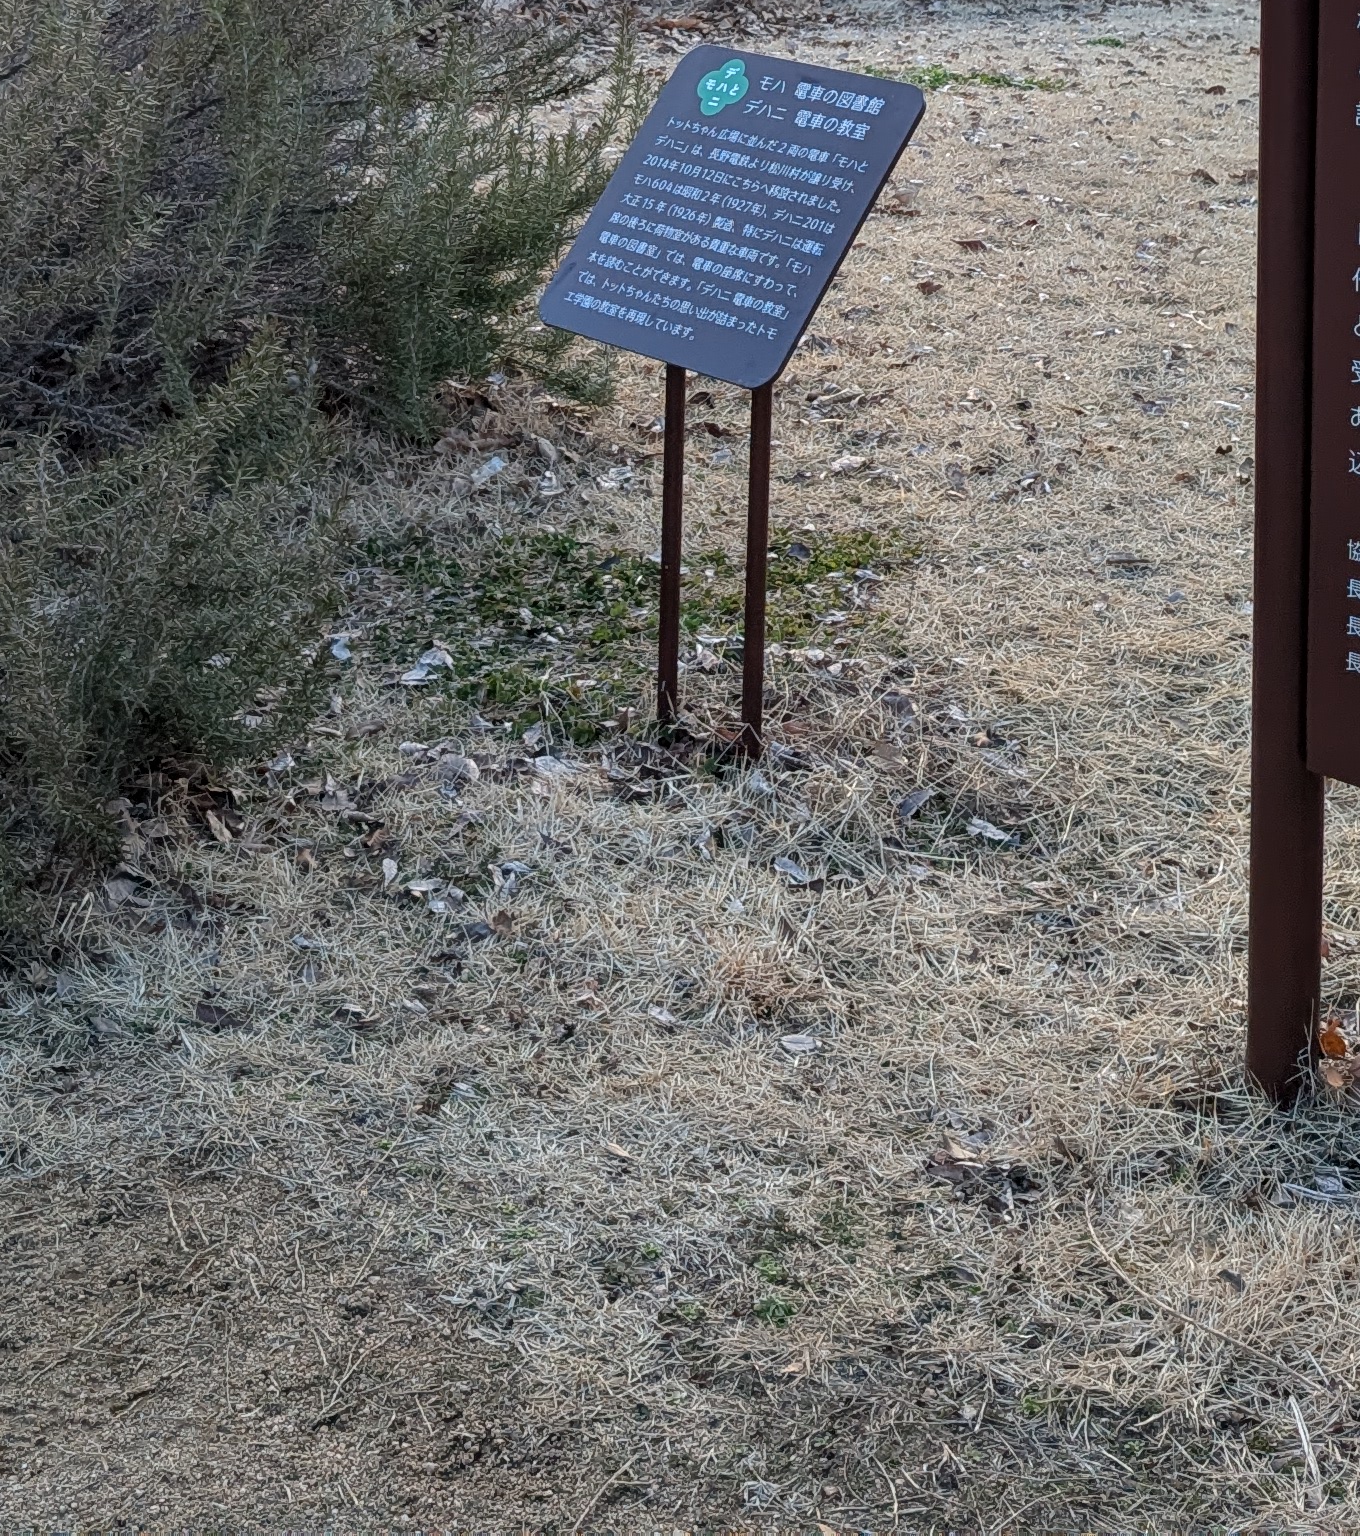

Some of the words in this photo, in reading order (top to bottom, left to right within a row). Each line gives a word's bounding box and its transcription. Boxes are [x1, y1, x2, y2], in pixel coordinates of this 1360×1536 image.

[724, 67, 741, 79] デ
[759, 75, 786, 94] モハ
[742, 99, 788, 120] デハニ
[793, 109, 871, 141] 電車の教室
